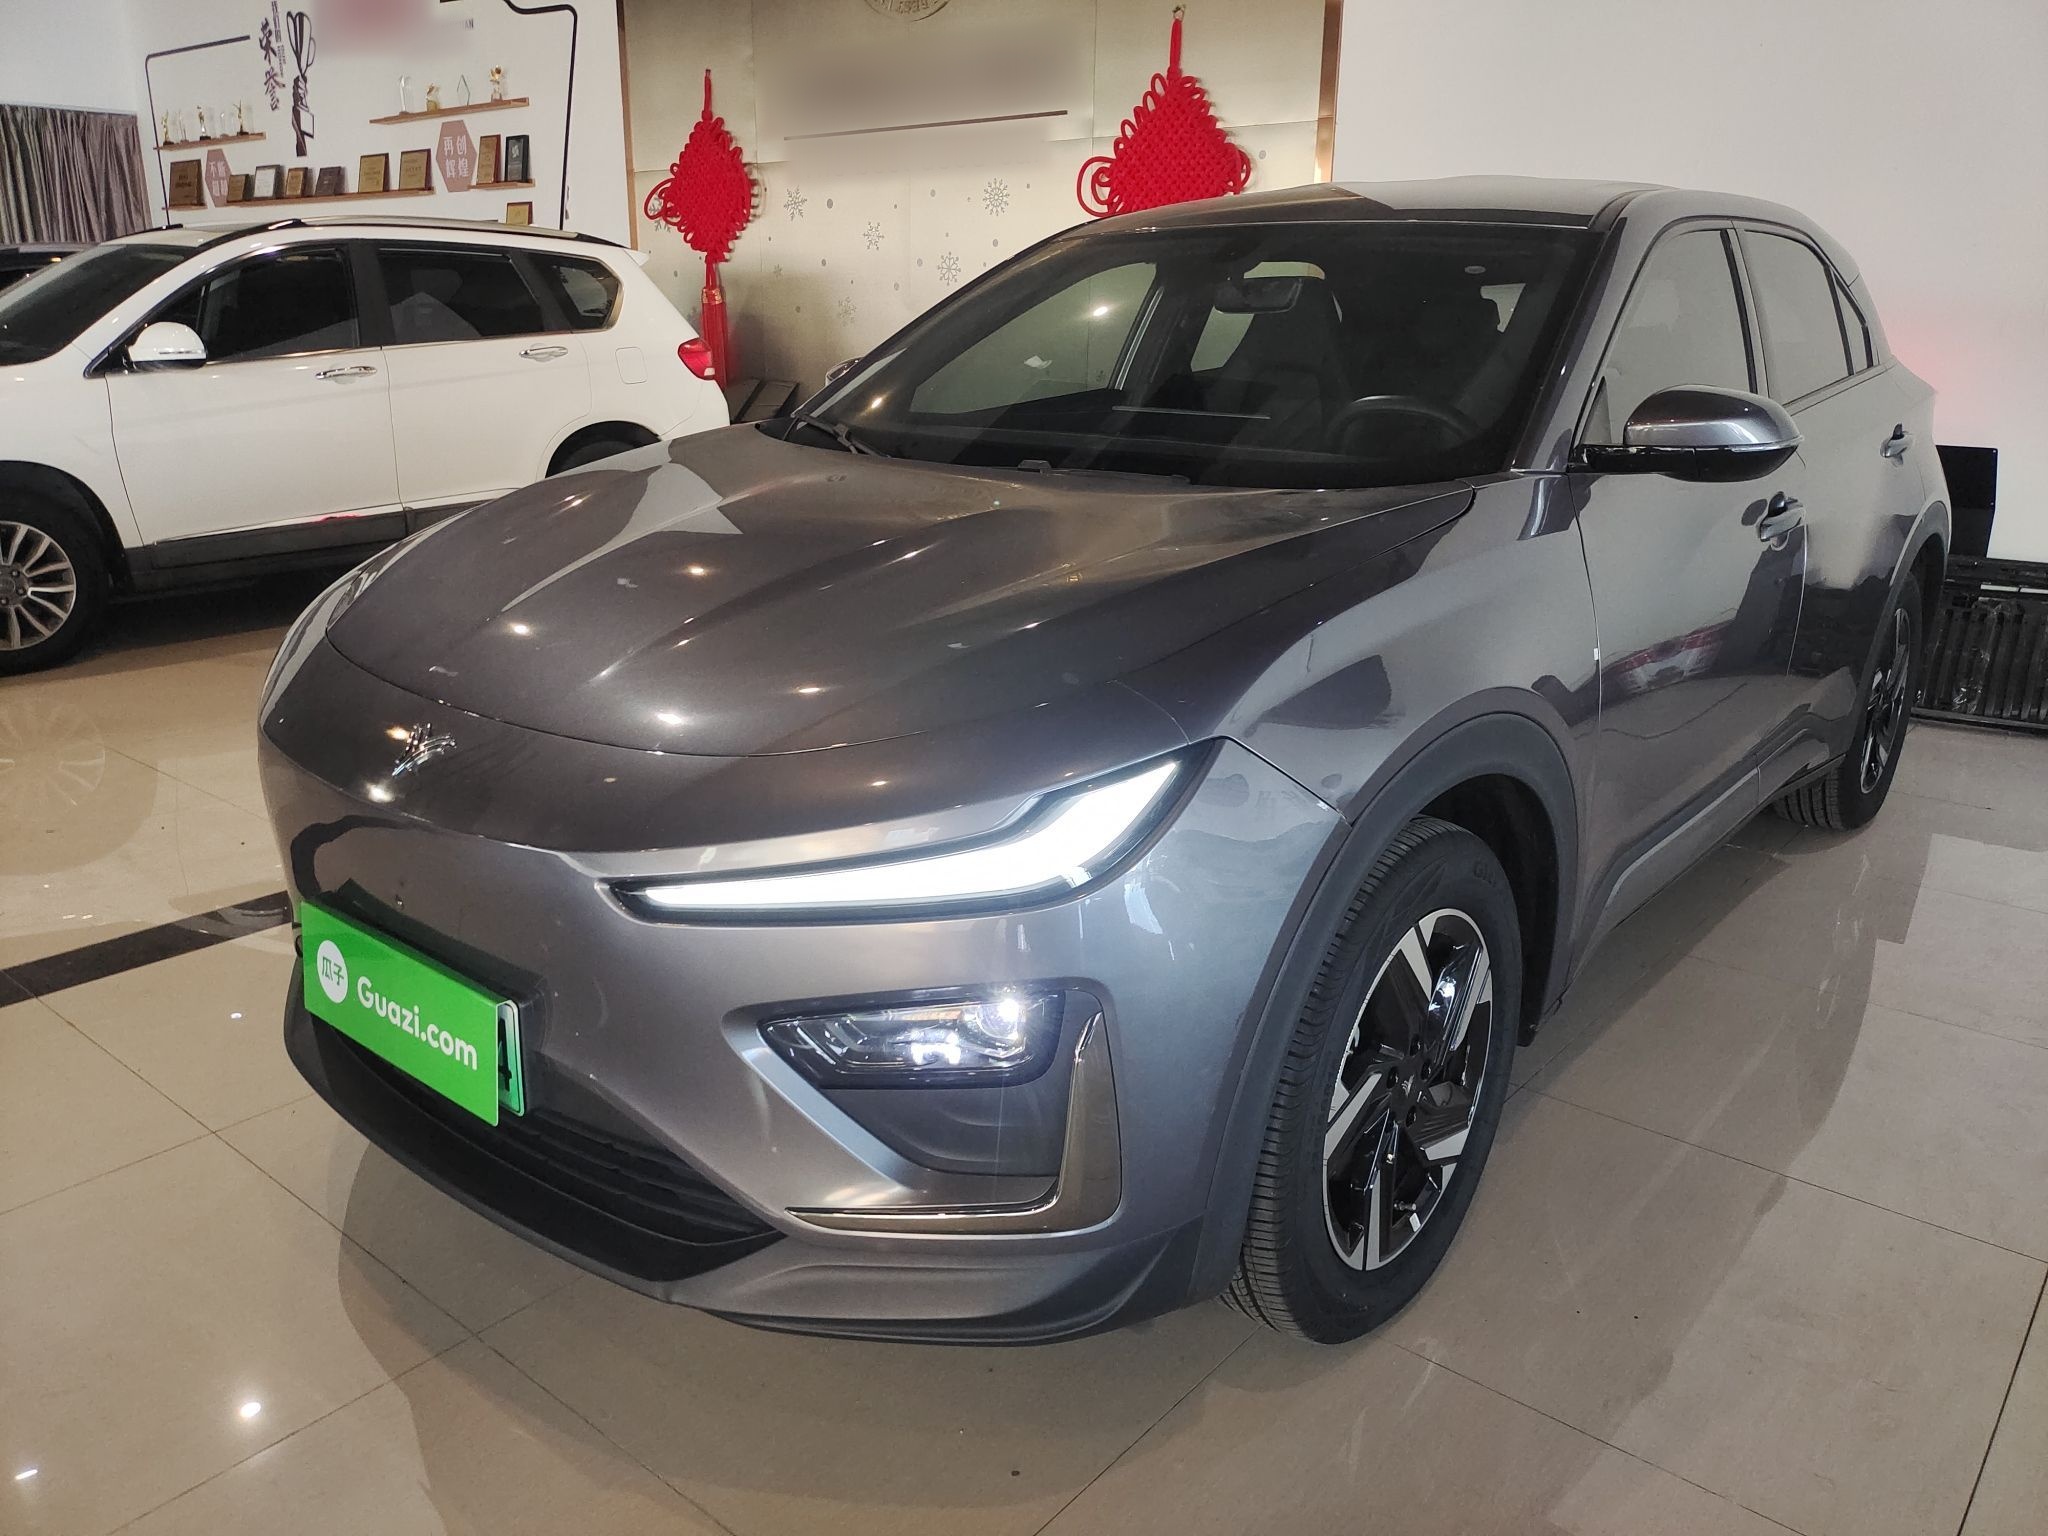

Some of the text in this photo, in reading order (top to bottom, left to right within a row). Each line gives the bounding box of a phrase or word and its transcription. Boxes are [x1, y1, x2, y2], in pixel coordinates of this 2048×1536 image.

[443, 135, 467, 156] 再创
[446, 158, 469, 178] 辉煌
[322, 956, 344, 986] 瓜子
[357, 976, 478, 1071] Guazi.com
